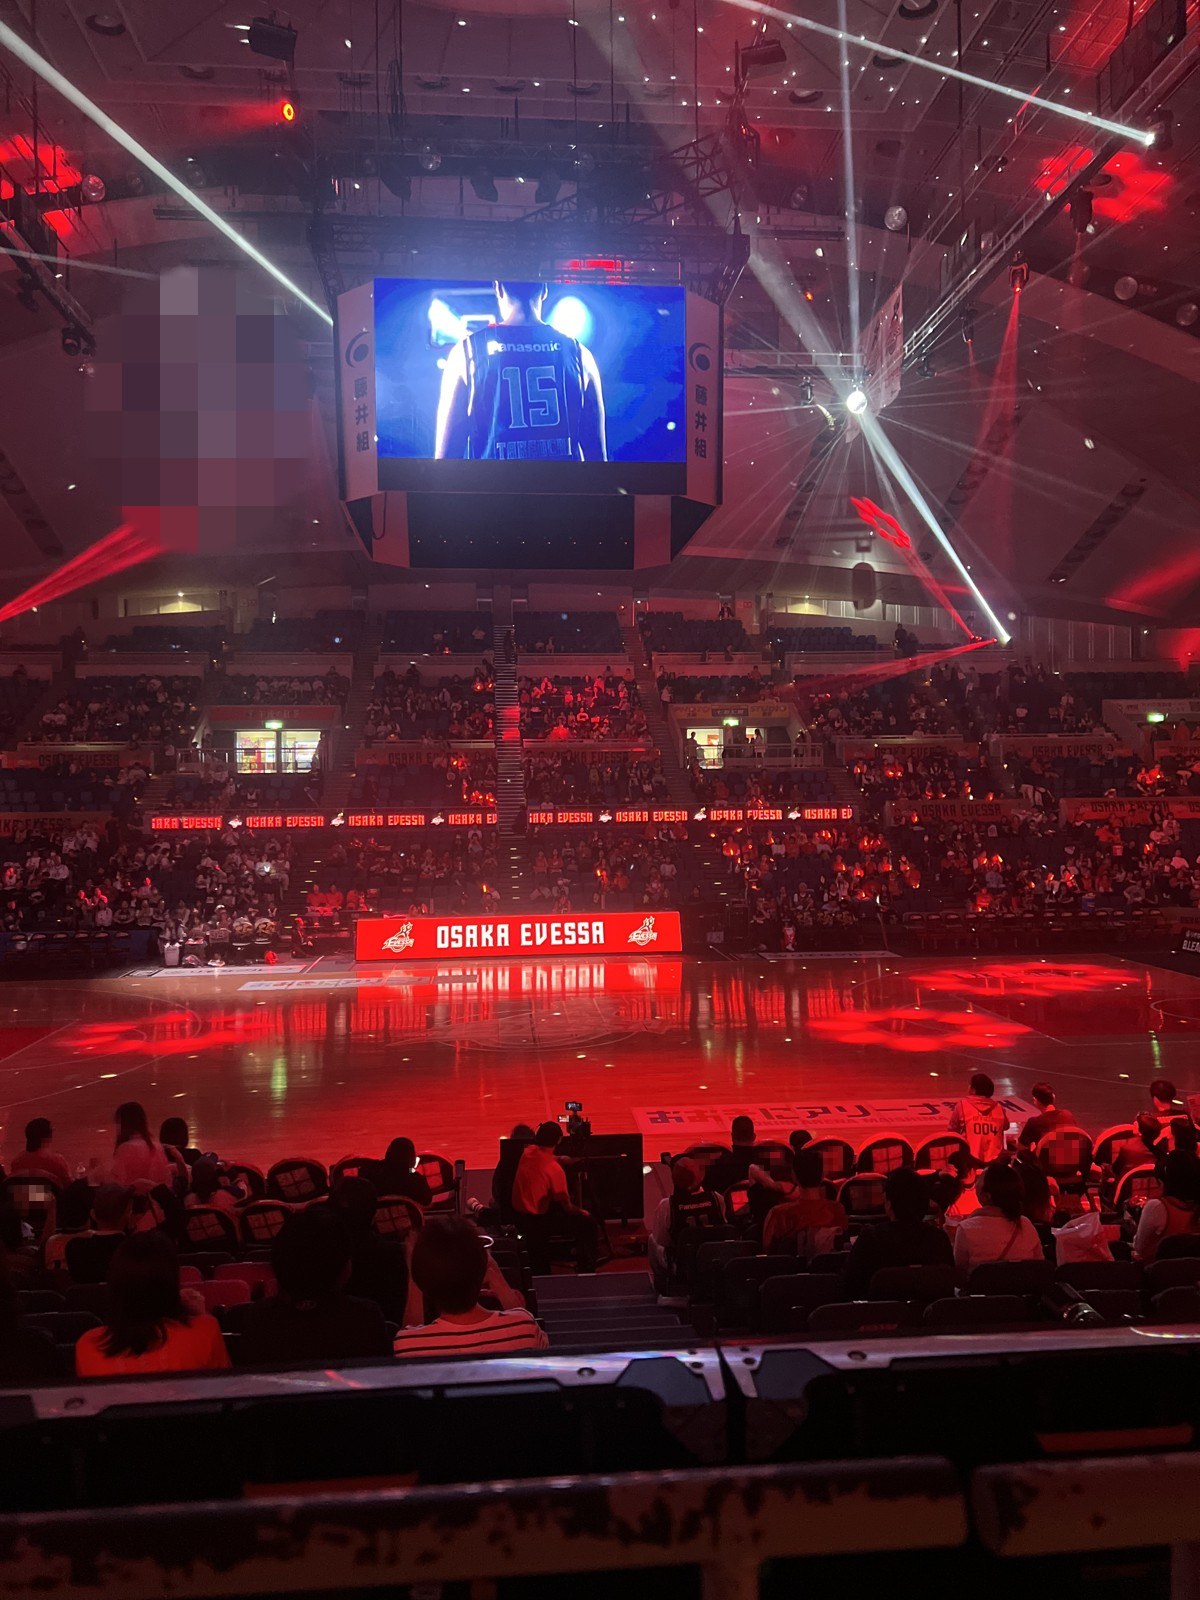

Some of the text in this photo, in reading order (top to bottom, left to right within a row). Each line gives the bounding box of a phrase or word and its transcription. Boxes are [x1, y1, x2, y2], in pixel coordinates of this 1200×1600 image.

[502, 366, 560, 429] 15
[711, 810, 743, 820] OSAKA
[805, 809, 837, 820] OSAKA
[921, 803, 1001, 817] OSAKA EVESSA
[246, 816, 324, 828] OSAKA EVESSA
[349, 815, 425, 826] OSAKA EVESSA
[449, 814, 482, 825] OSAKA
[557, 812, 593, 823] EVESSA
[616, 811, 688, 822] OSAKA EVESSA
[437, 921, 605, 949] OSAKA EVESSA
[973, 1122, 998, 1137] 004
